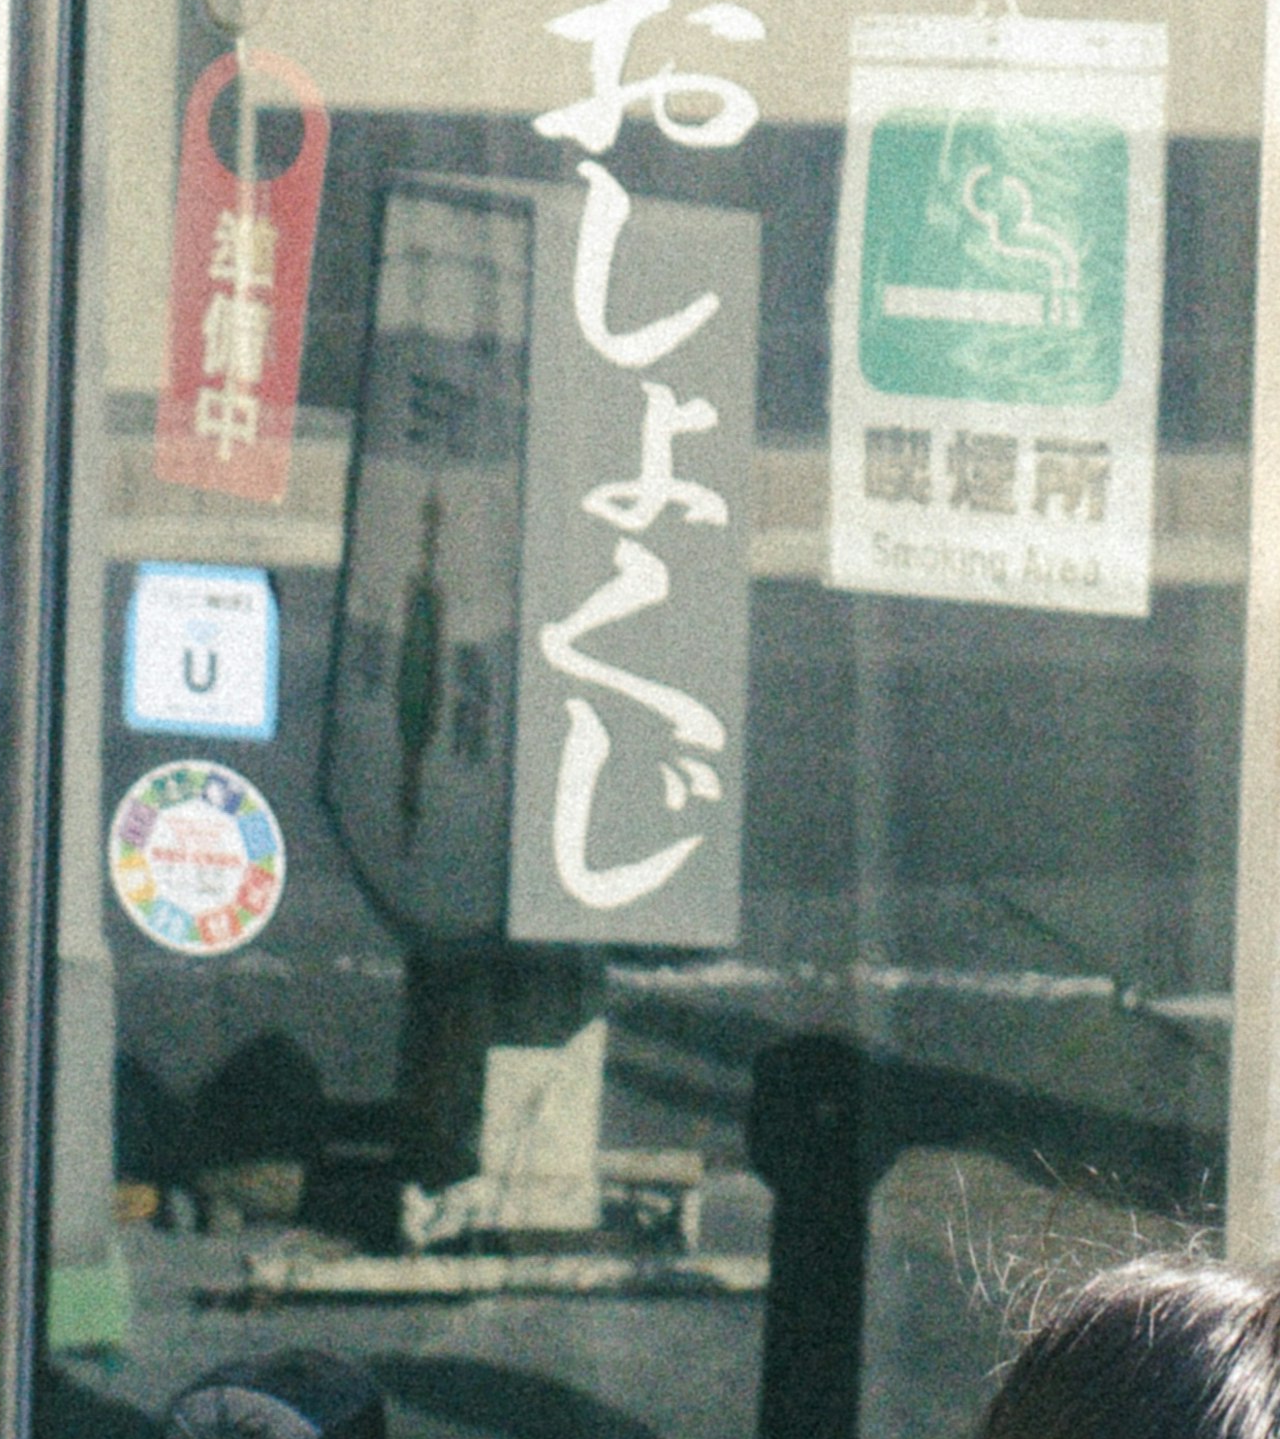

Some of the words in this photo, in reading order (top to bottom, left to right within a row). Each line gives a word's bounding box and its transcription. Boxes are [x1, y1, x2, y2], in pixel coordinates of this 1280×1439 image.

[863, 425, 1112, 523] 喫煙所
[871, 530, 1008, 584] Smoking
[1022, 544, 1102, 588] Area
